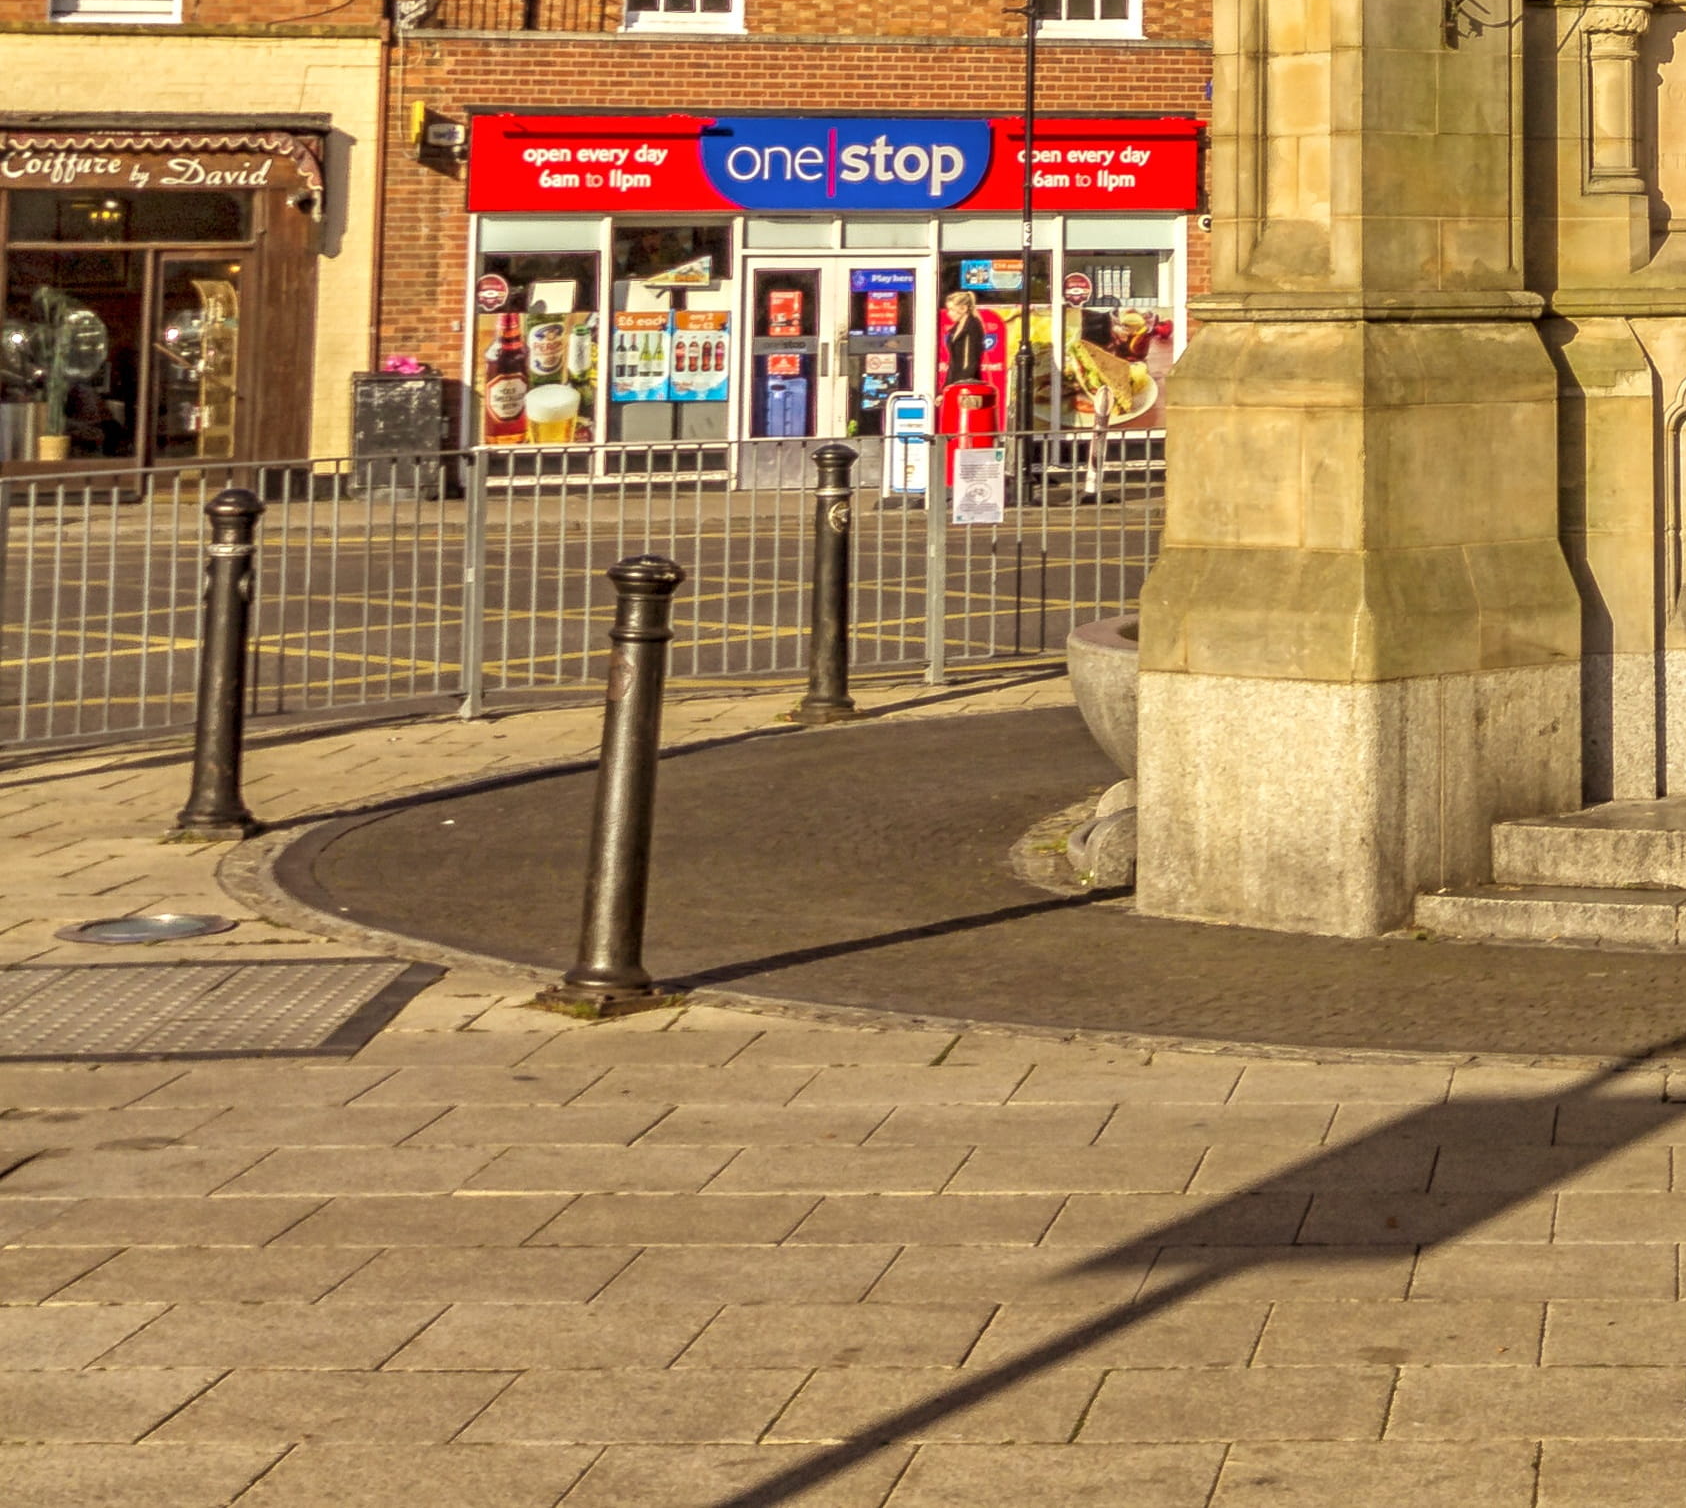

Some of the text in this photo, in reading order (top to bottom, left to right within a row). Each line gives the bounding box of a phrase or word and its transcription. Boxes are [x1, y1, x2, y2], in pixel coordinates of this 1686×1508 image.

[522, 143, 669, 167] open every day
[839, 134, 965, 197] stop
[1067, 149, 1115, 167] every
[1119, 145, 1151, 167] day
[0, 150, 273, 188] Coiffure by David
[538, 169, 652, 192] 6am to 11pm
[1032, 169, 1136, 192] 6am to 11pm
[871, 274, 891, 283] Play
[617, 315, 666, 327] £6 each
